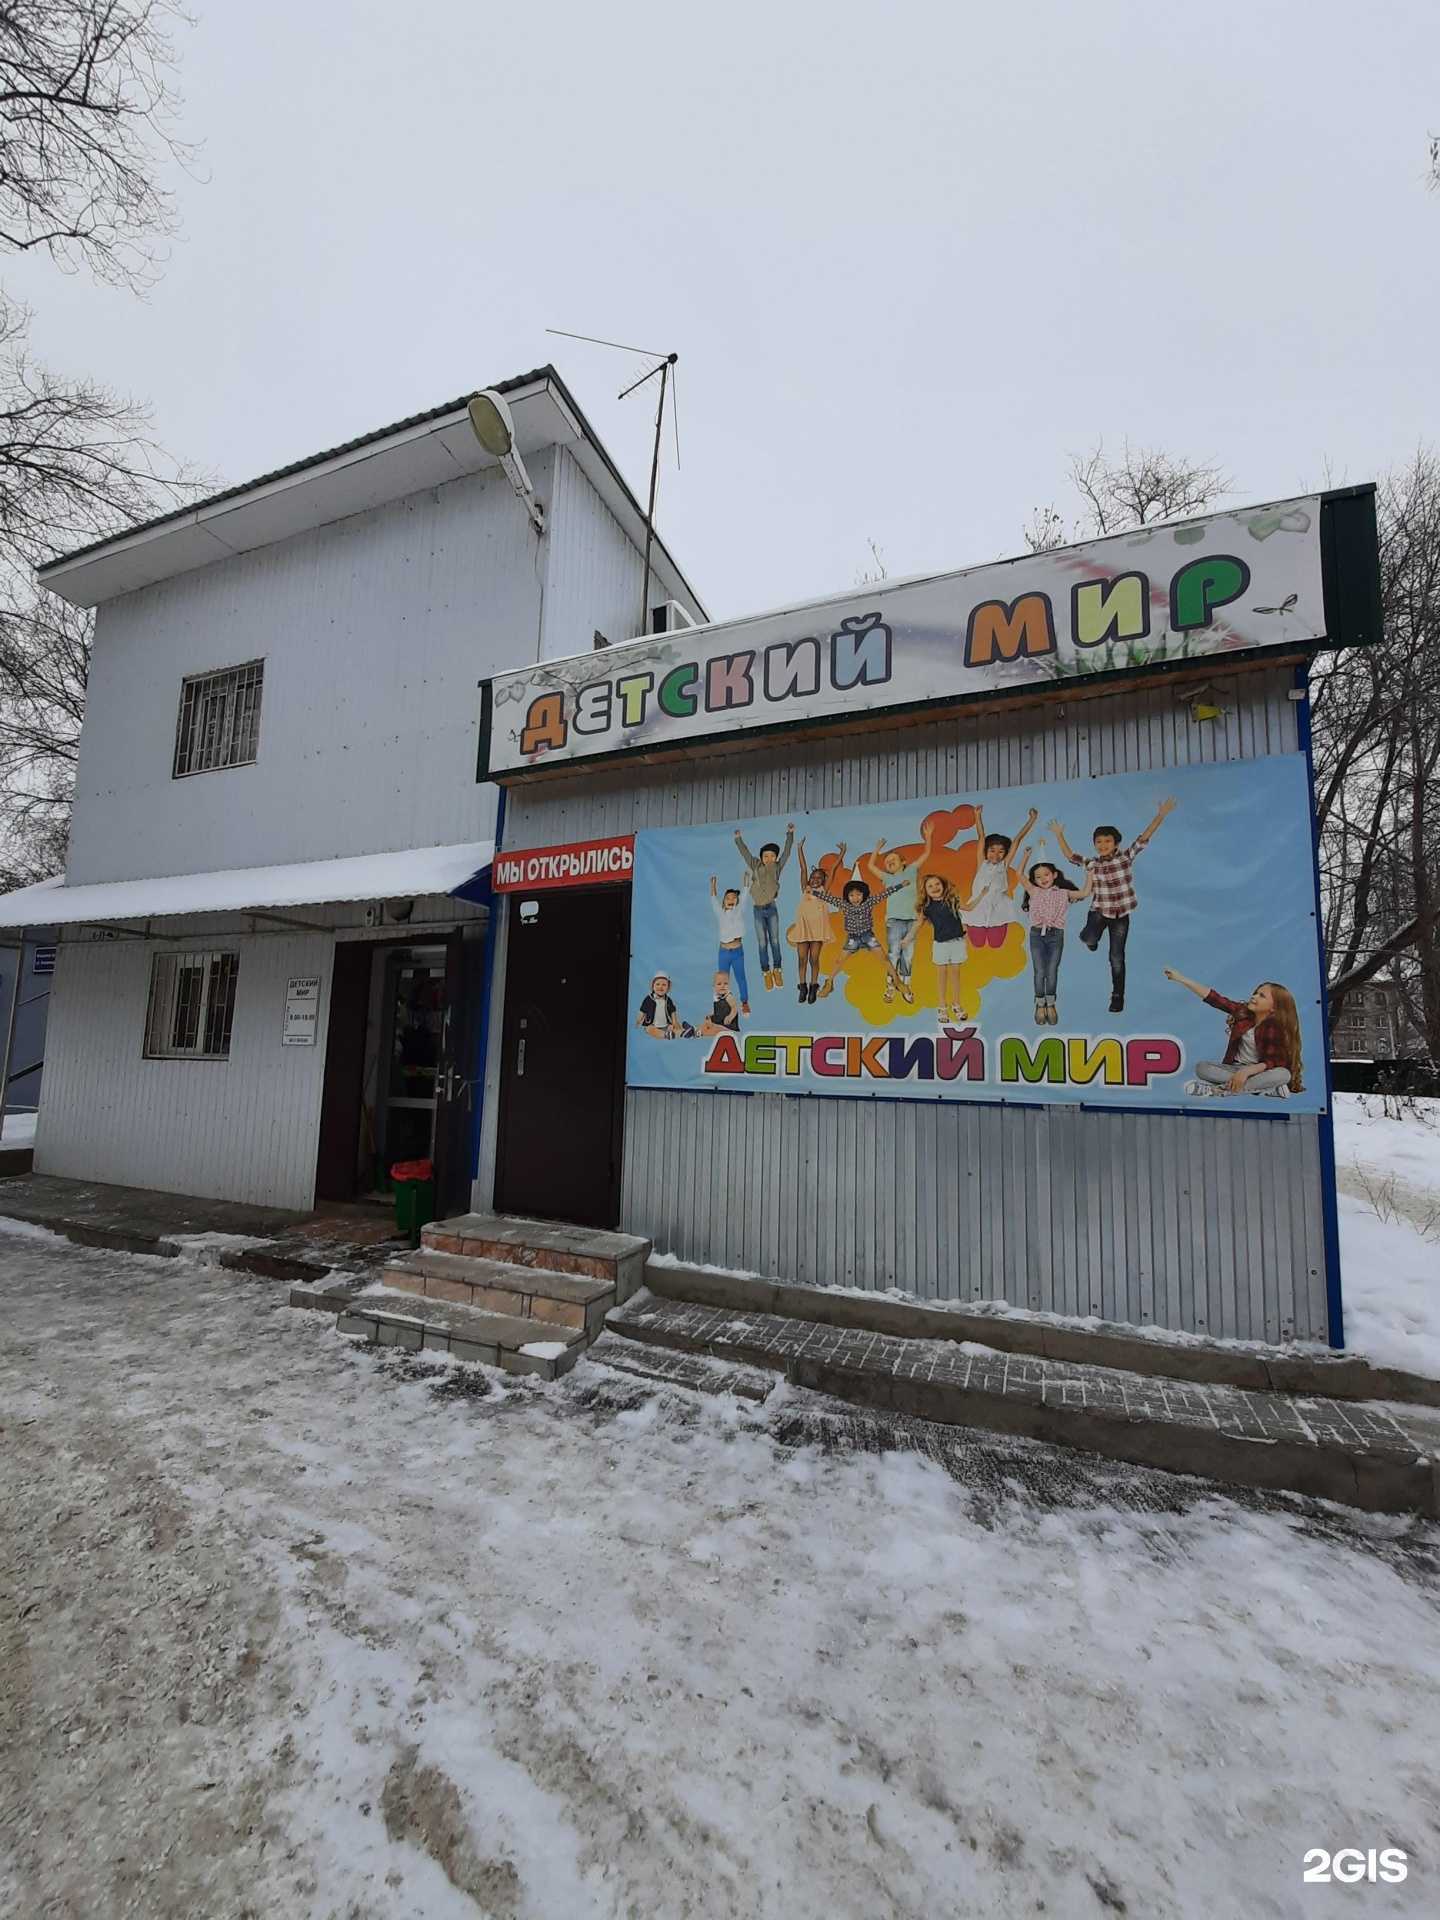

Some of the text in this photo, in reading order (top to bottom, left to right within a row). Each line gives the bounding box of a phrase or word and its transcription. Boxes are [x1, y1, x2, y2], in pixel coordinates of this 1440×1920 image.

[520, 554, 1251, 755] ДЕТСКИЙ МИР
[496, 846, 633, 885] МЫ ОТКРЫЛИСЬ
[704, 1027, 1182, 1086] ДЕТСКИЙ МИР
